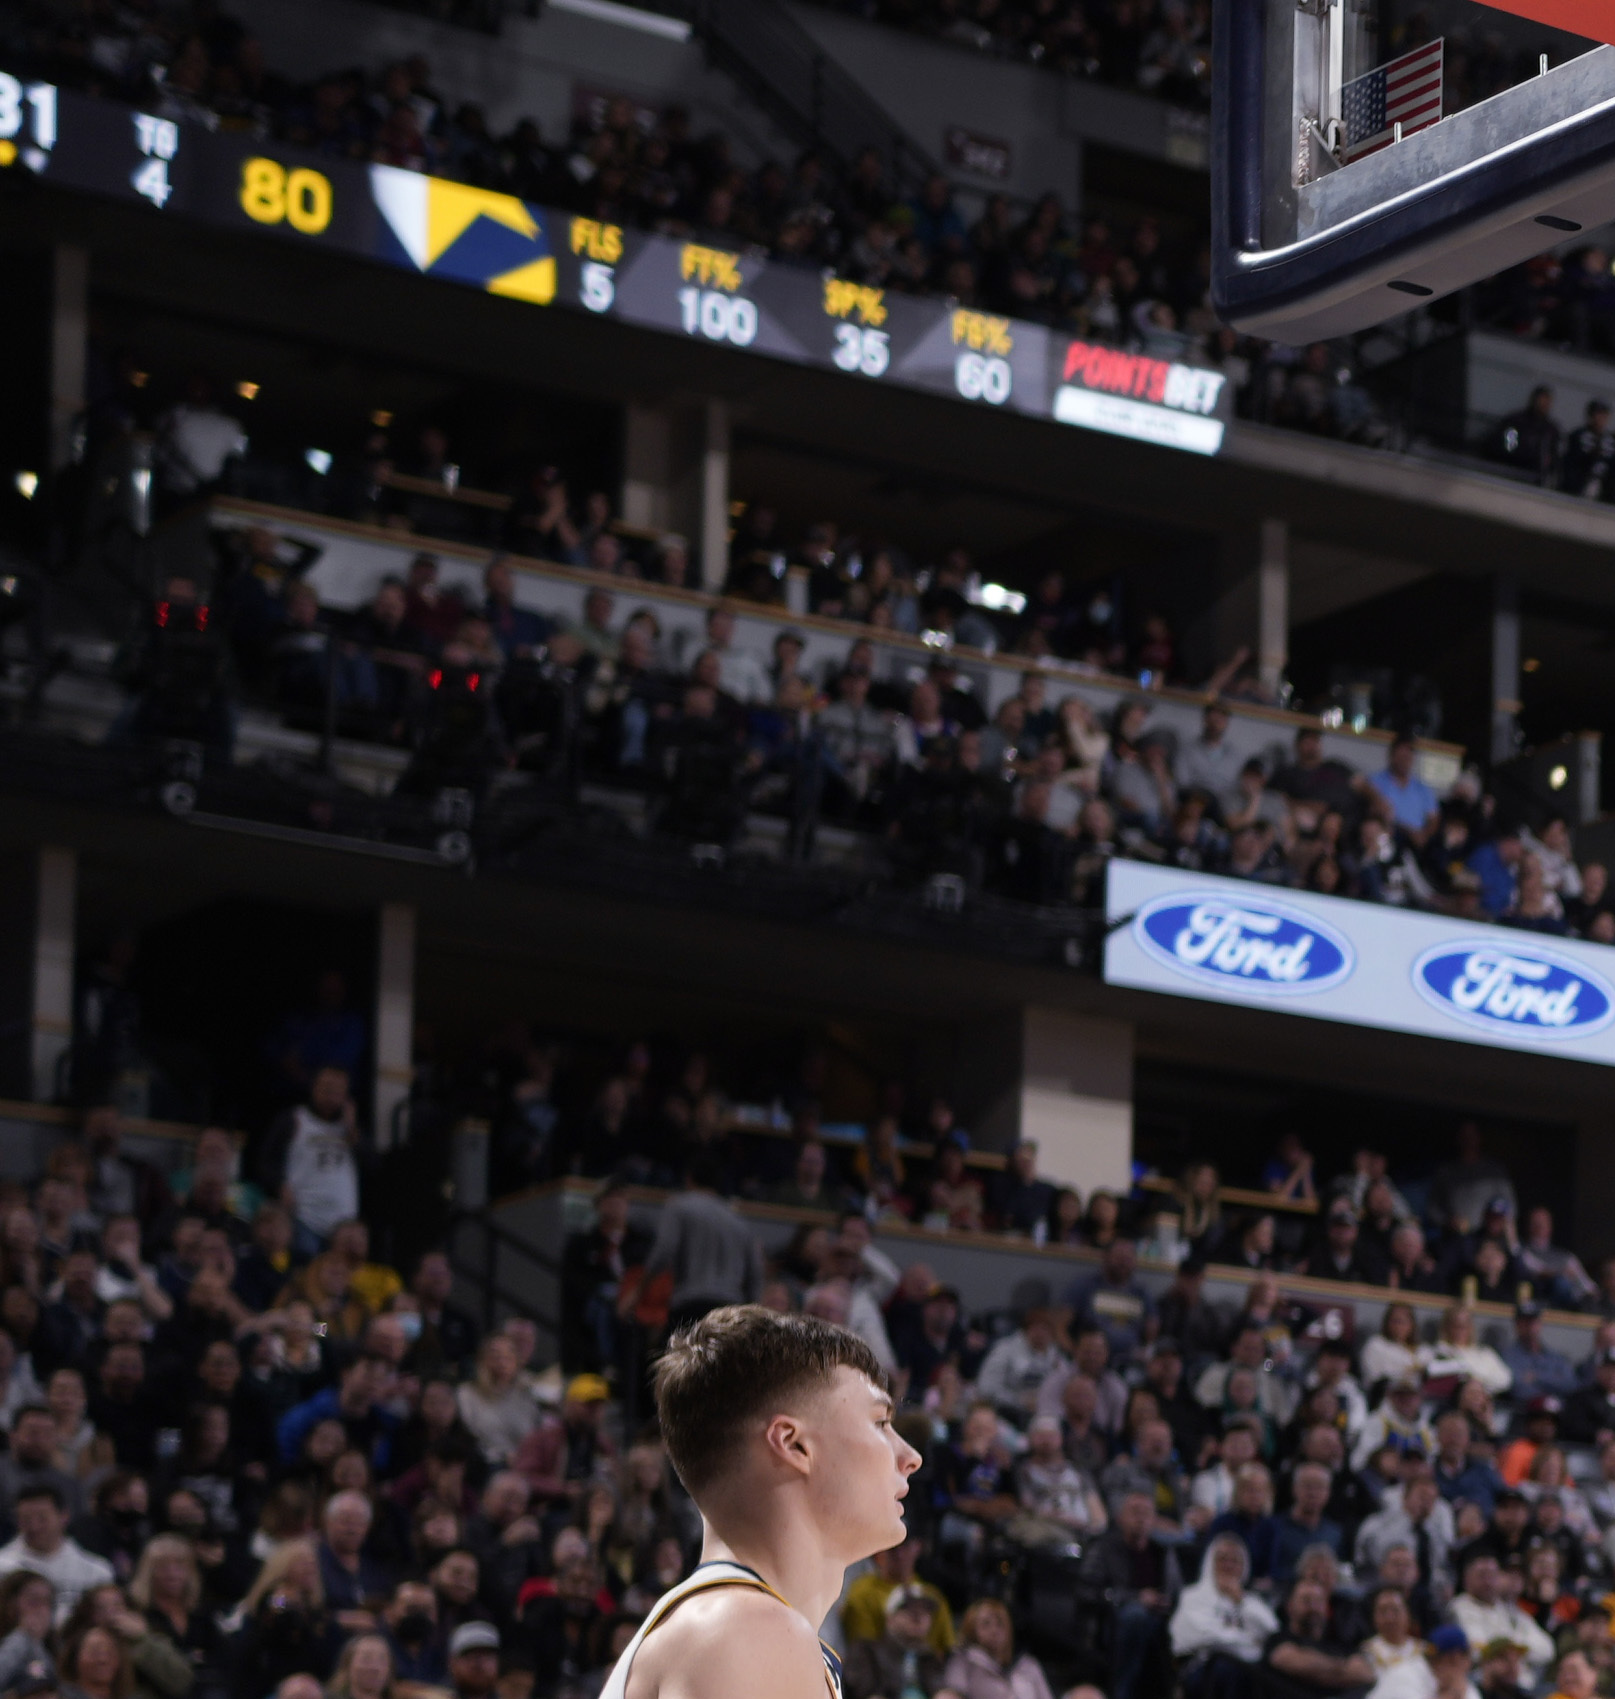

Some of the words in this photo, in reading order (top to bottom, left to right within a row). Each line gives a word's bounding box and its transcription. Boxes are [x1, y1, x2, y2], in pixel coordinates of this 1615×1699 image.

[131, 156, 173, 209] 4
[240, 156, 333, 235] 80
[570, 215, 624, 264] FLS
[580, 260, 615, 313] 5
[679, 286, 758, 347] 100
[831, 322, 890, 378] 35
[955, 351, 1012, 405] 60
[1062, 340, 1226, 415] POINTSBET
[1174, 901, 1314, 983] Ford
[1450, 950, 1582, 1030] Ford
